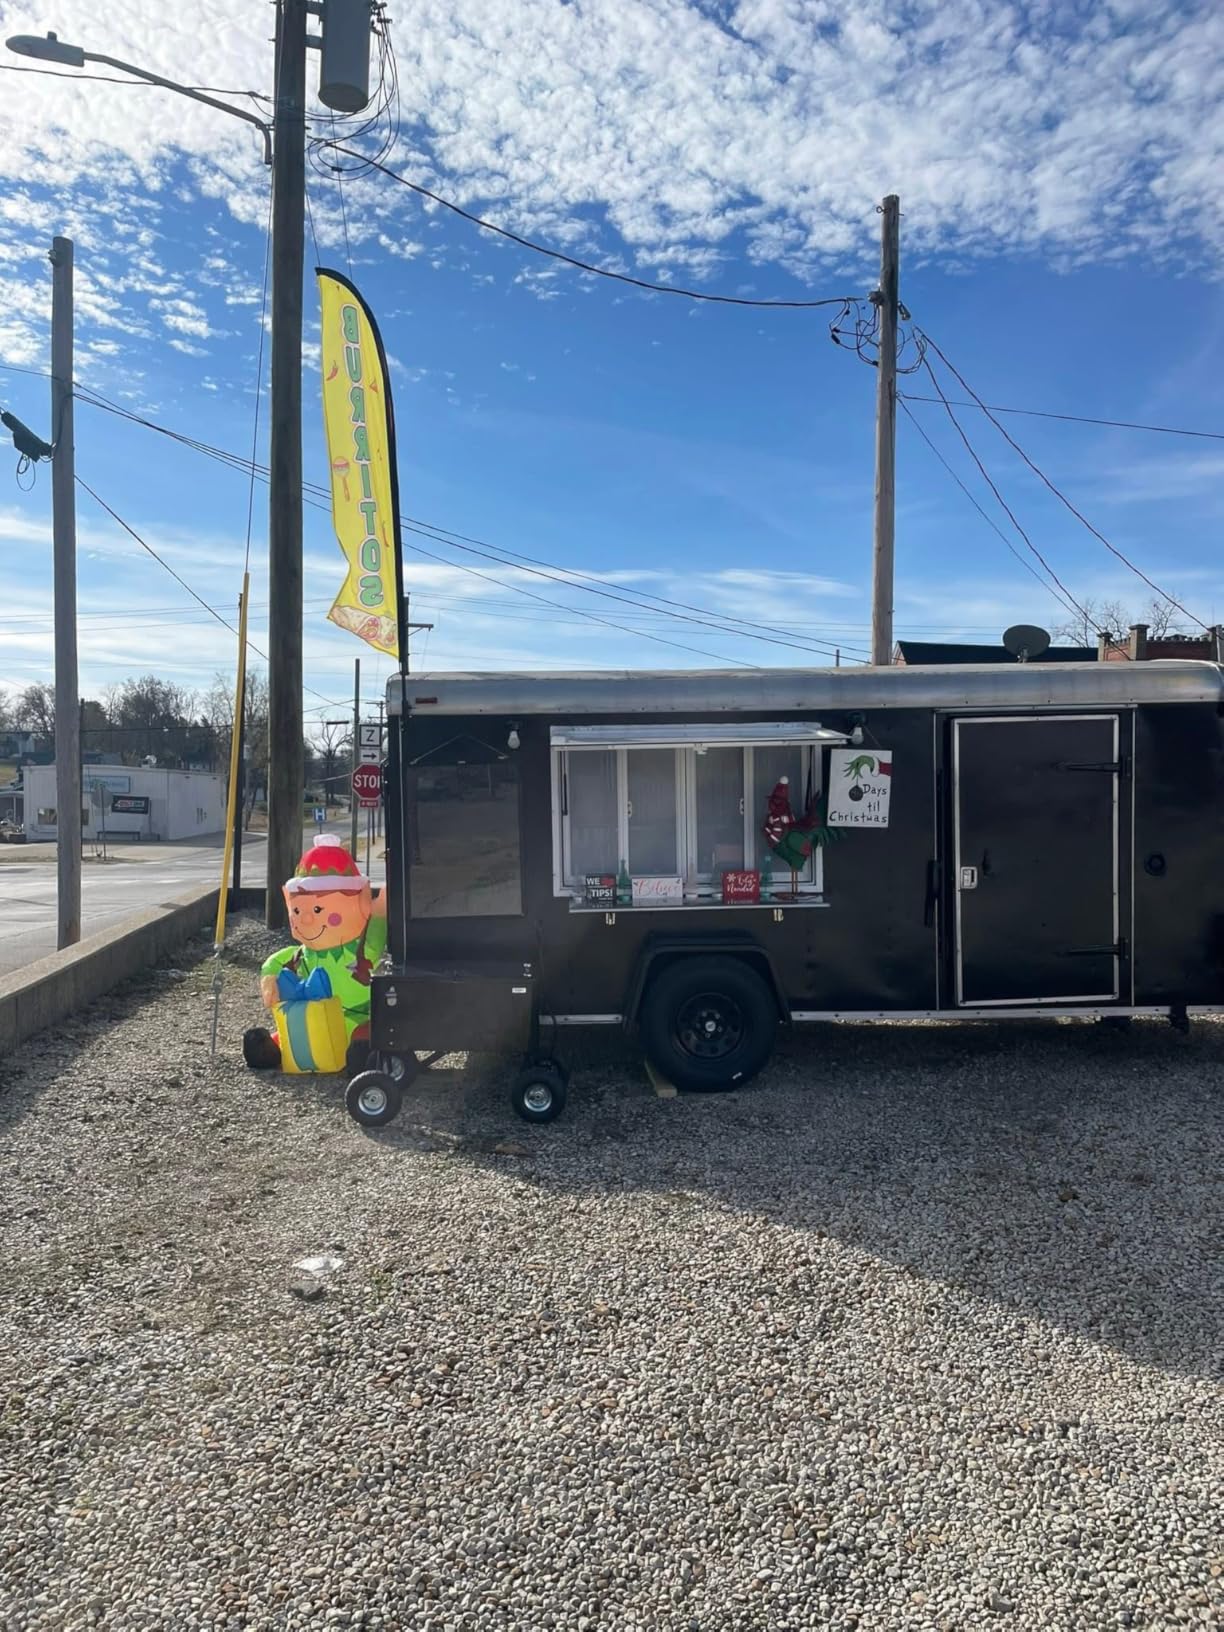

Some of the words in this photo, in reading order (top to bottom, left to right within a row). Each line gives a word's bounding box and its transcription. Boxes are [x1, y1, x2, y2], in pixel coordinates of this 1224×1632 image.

[366, 729, 375, 741] Z
[862, 784, 887, 796] Days
[867, 800, 880, 812] til
[315, 809, 325, 820] H
[829, 810, 887, 823] Christmas
[586, 877, 600, 886] WE
[591, 888, 613, 897] TIPS!
